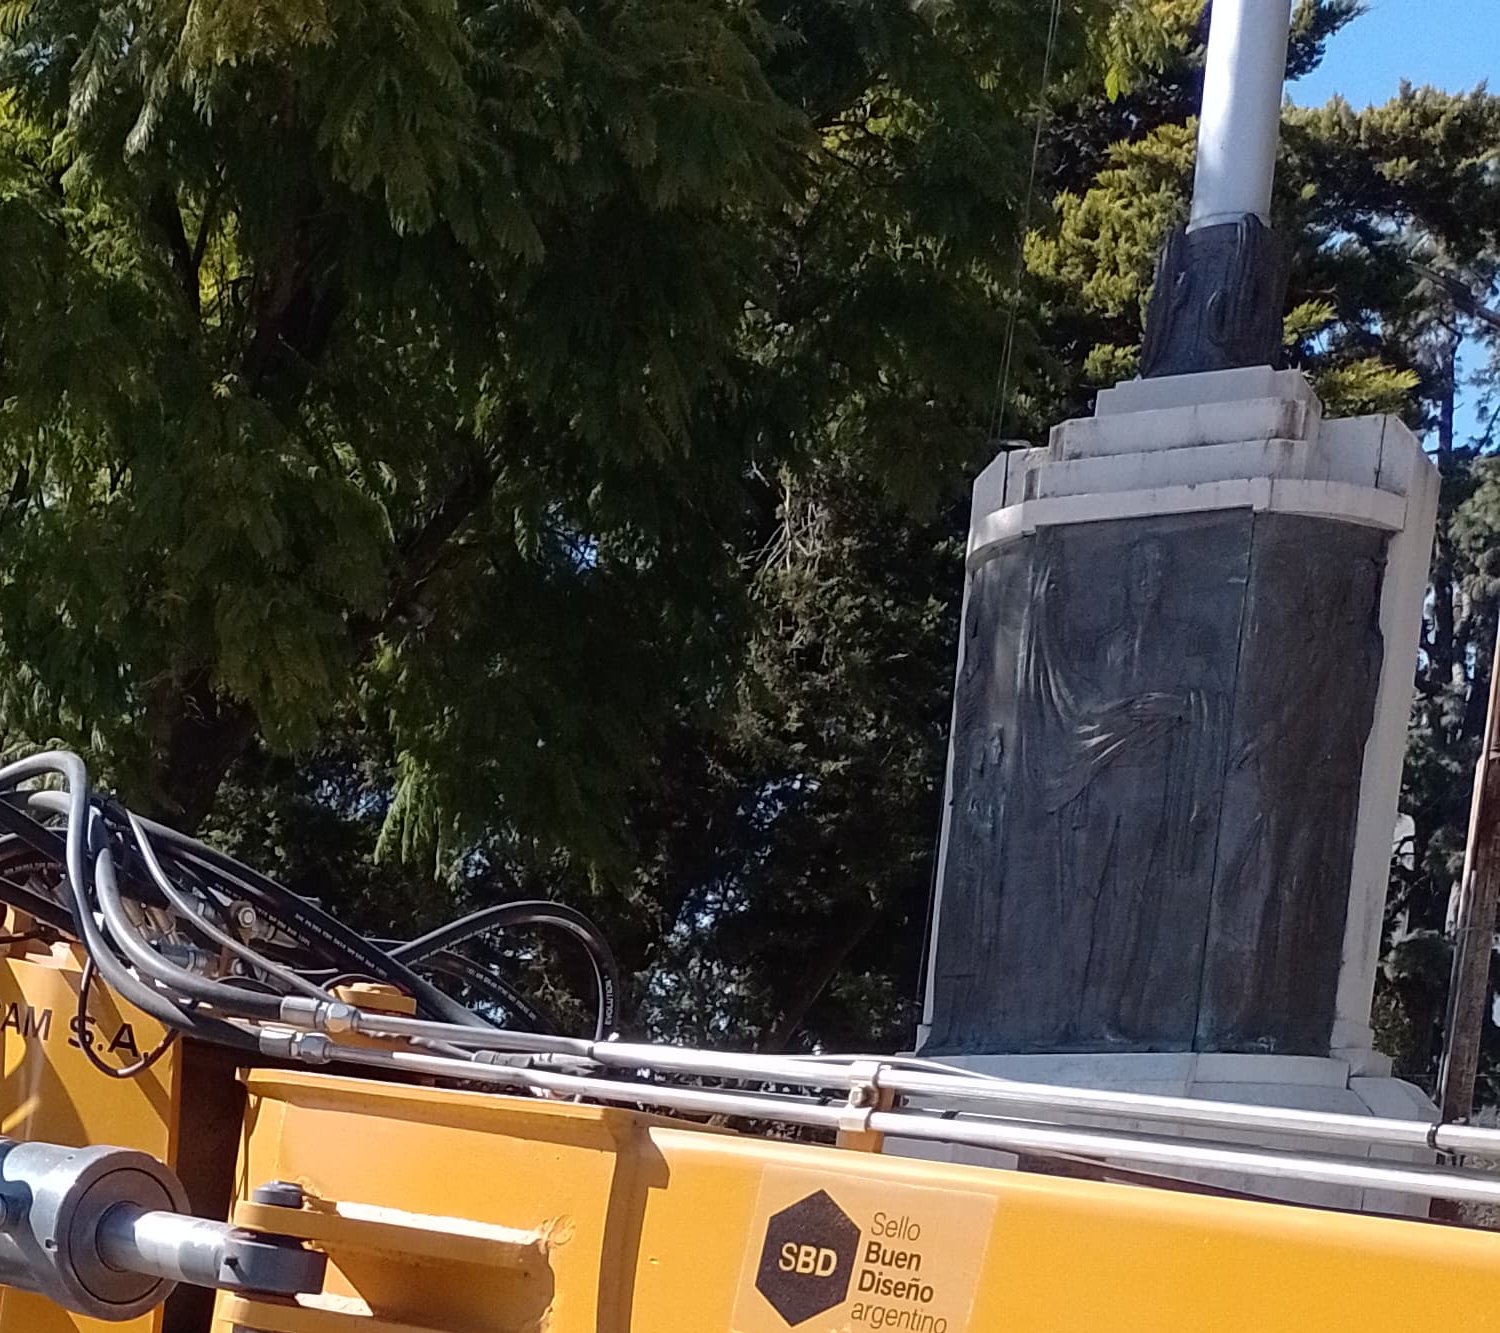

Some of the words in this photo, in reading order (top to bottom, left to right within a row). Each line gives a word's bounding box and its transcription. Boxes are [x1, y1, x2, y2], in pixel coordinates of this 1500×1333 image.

[870, 1211, 921, 1241] Sello
[778, 1242, 838, 1278] SBD
[864, 1240, 922, 1272] Buen
[857, 1269, 934, 1303] Diseño
